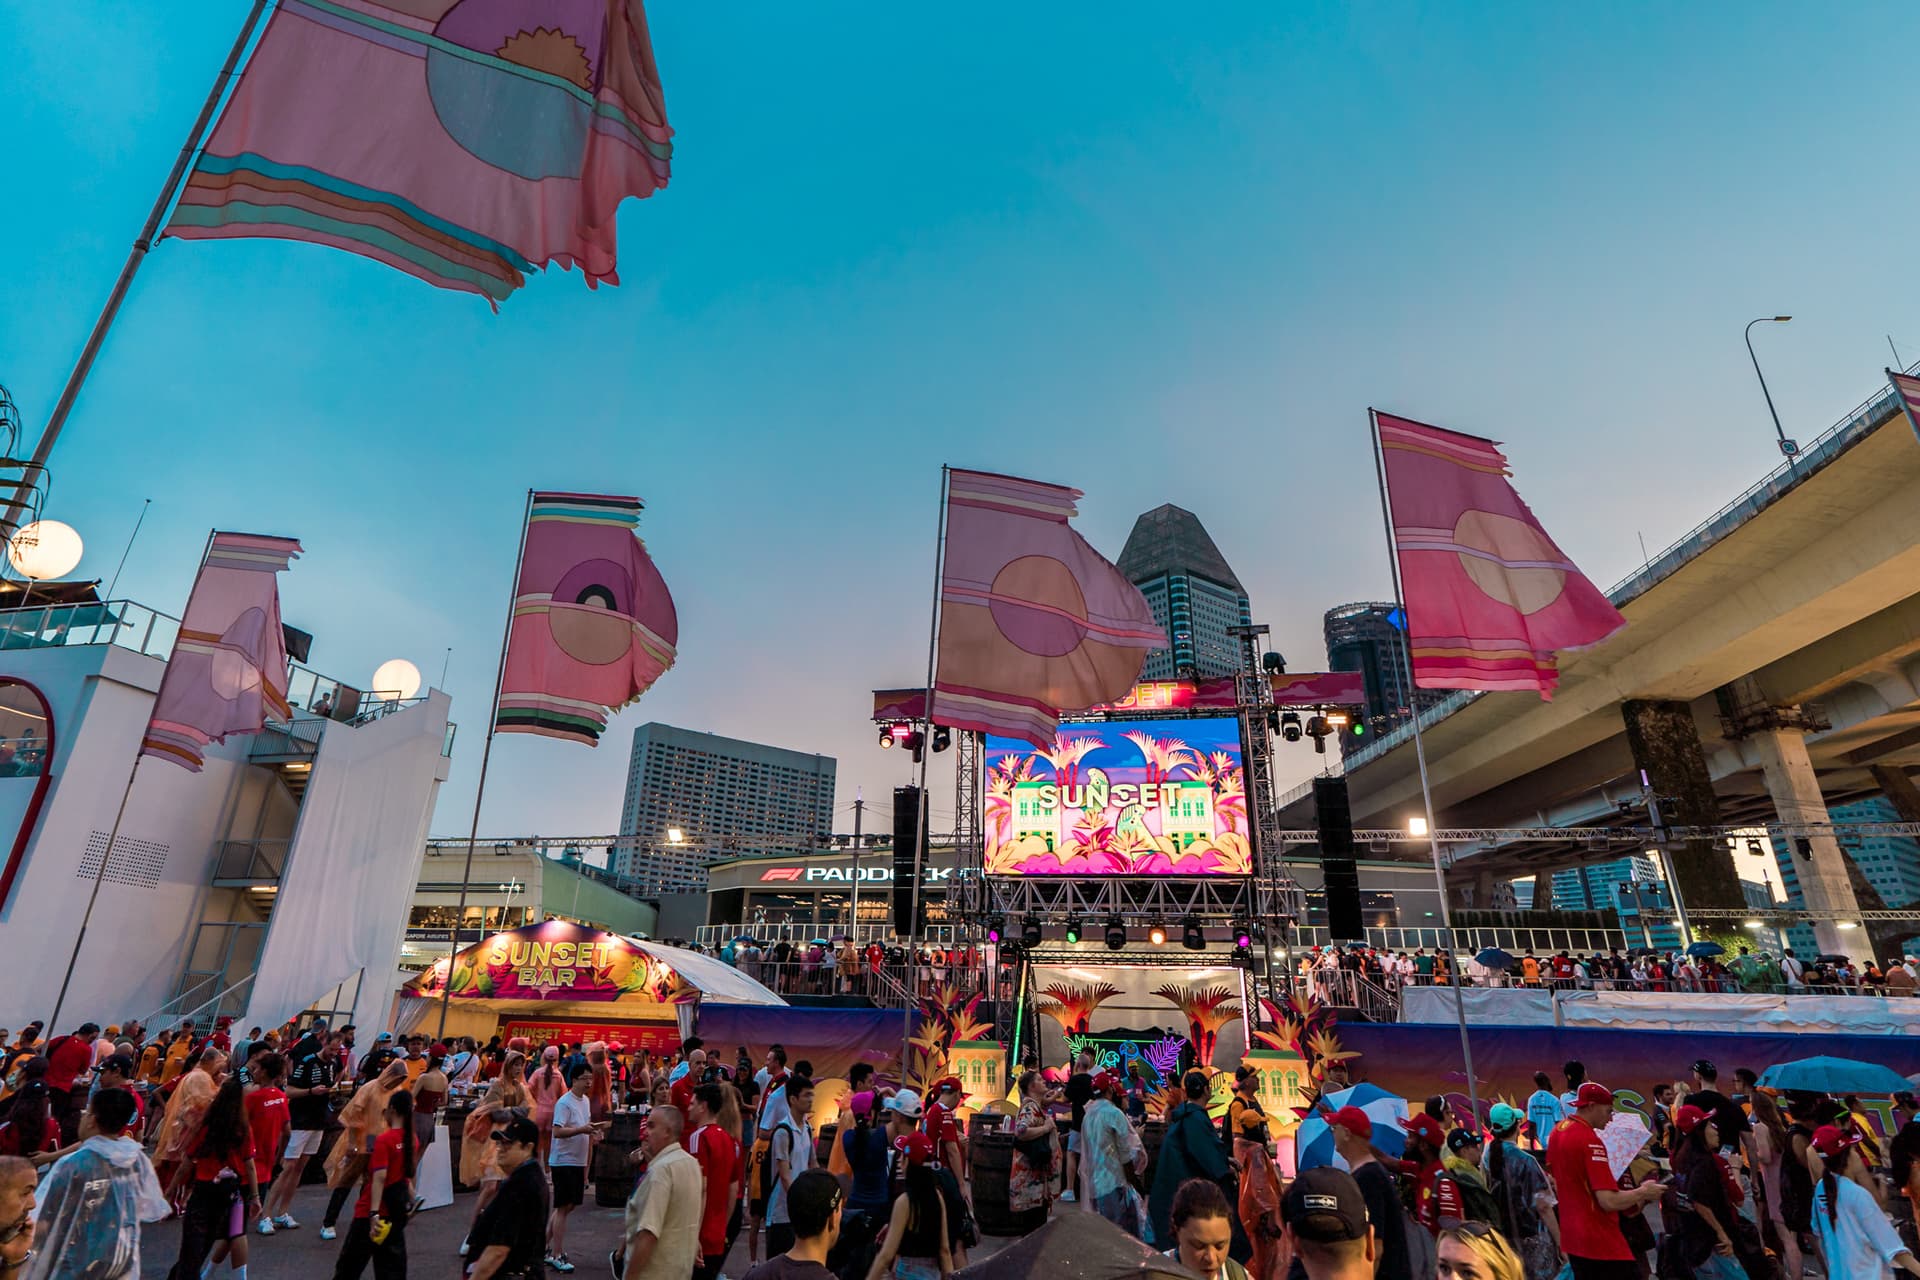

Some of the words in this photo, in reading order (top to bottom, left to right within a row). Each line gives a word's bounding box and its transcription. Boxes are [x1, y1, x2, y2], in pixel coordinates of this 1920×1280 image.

[1039, 783, 1181, 809] SUNSET
[489, 941, 614, 968] SUNSET
[518, 968, 577, 987] BAR
[511, 1027, 561, 1040] SUNSET
